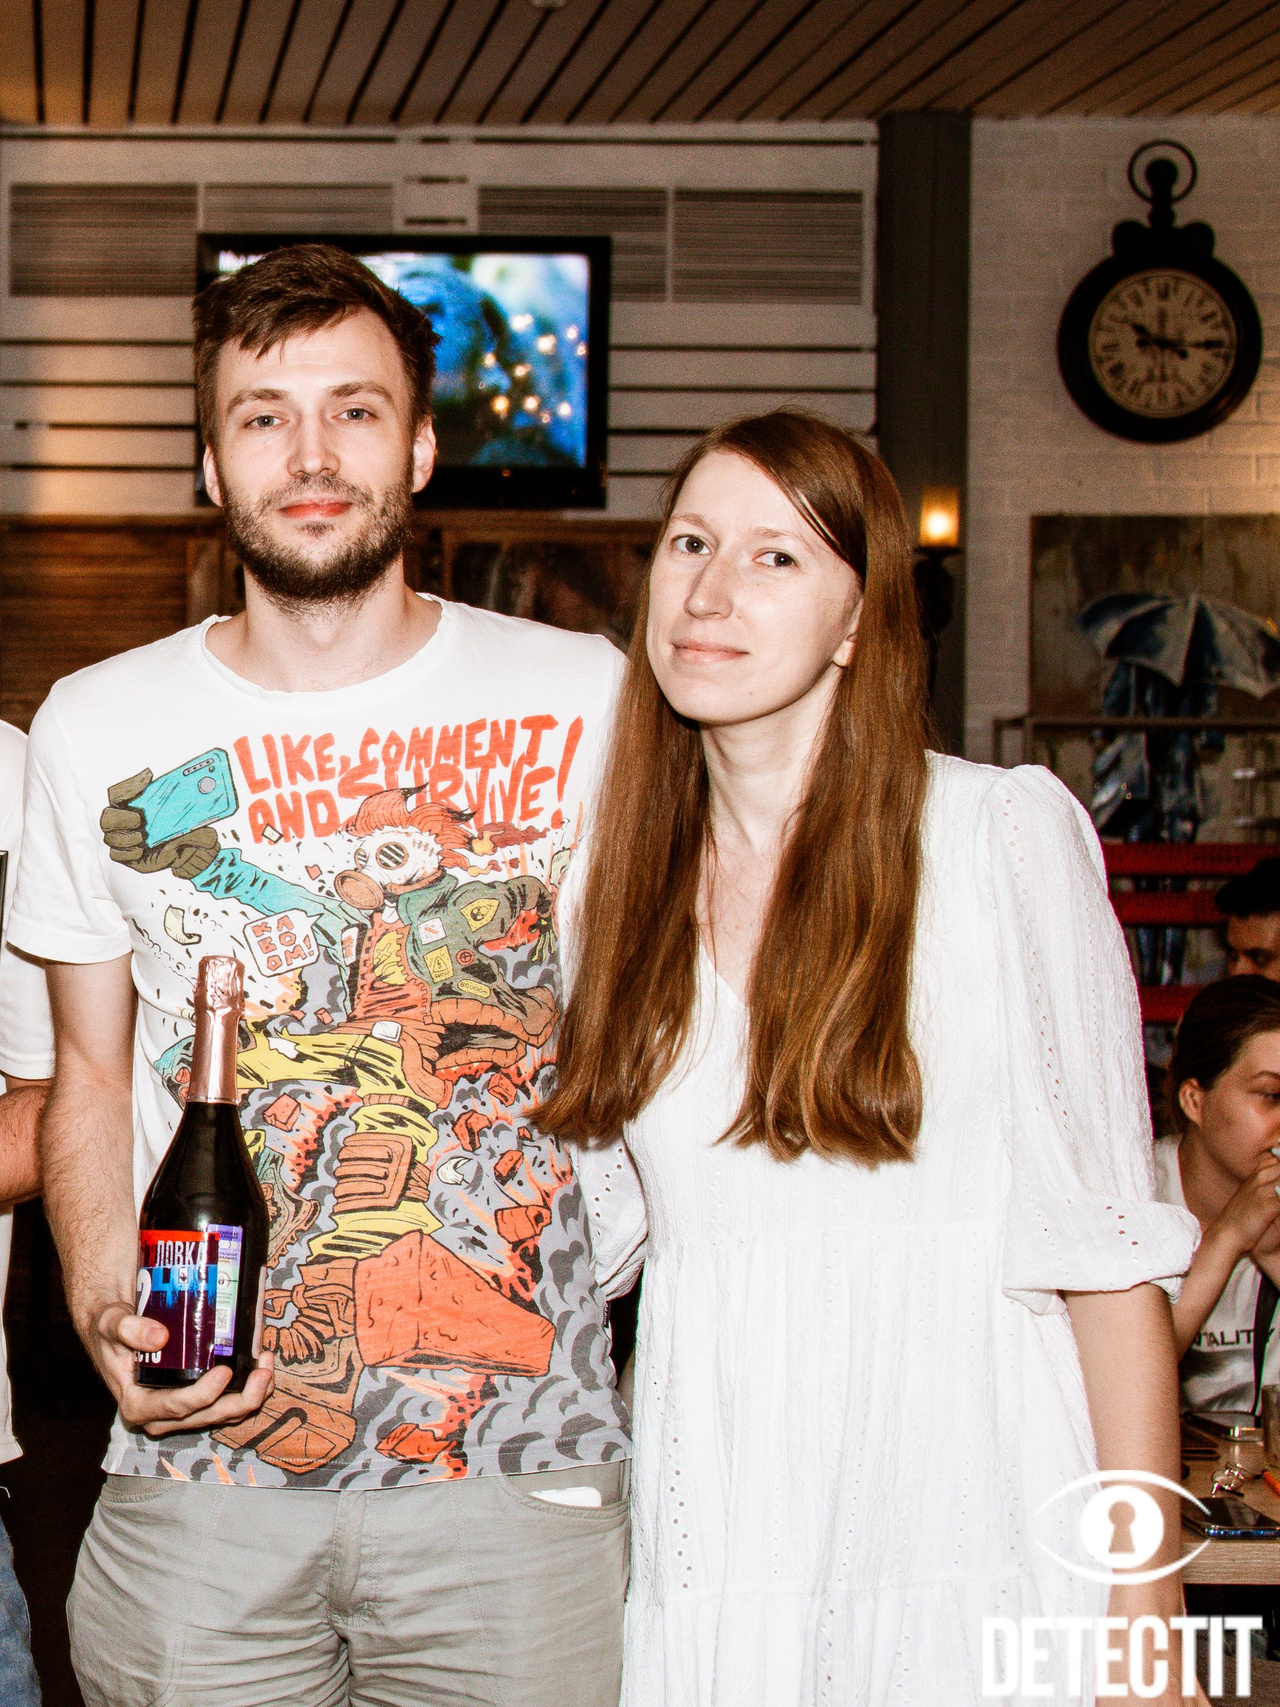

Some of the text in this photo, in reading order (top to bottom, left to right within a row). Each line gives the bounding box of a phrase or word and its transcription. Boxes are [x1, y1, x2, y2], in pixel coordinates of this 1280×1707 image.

[233, 714, 559, 795] LIKE, COMMENT
[247, 789, 341, 845] AND
